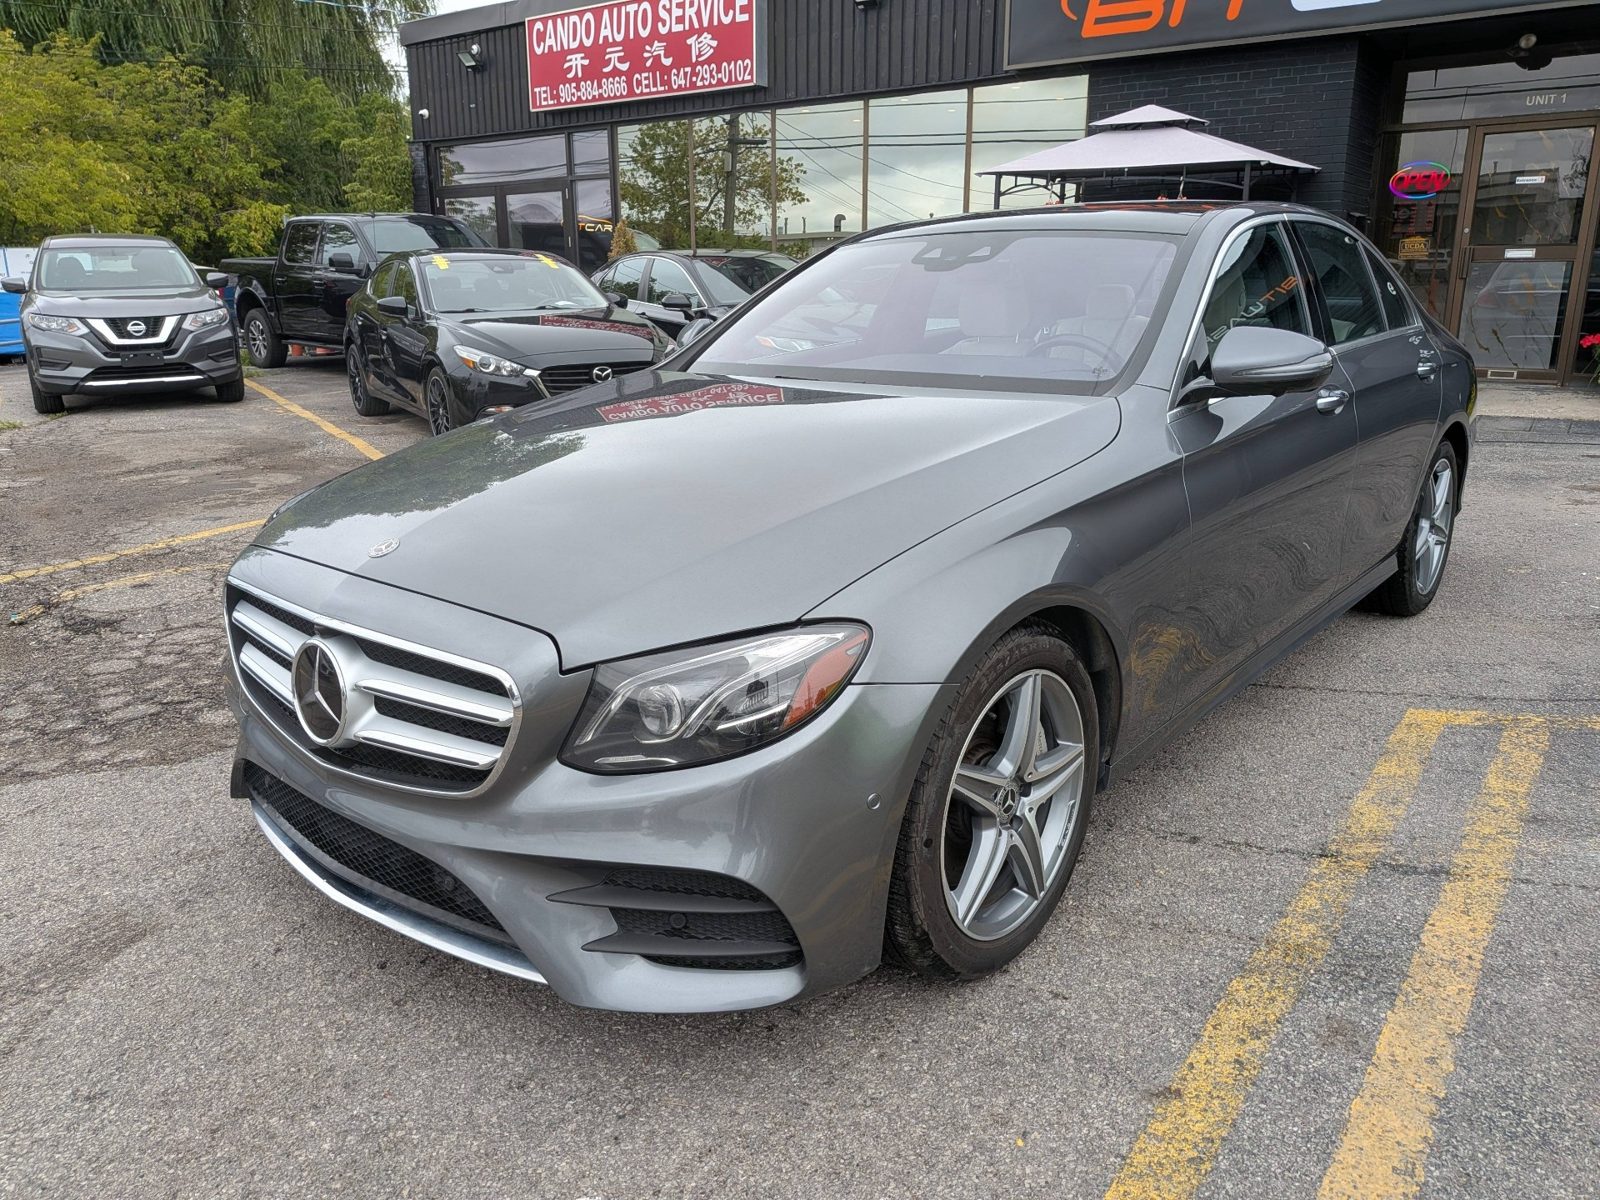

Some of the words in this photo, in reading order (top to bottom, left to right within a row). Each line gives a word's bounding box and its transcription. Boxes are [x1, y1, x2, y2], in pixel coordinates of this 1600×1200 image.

[532, 12, 595, 55] CANDO
[598, 1, 652, 45] AUTO
[657, 0, 749, 35] SERVICE
[563, 32, 718, 79] 开元汽修
[534, 86, 557, 106] TEL:
[559, 75, 628, 103] 905-884-8666
[633, 71, 668, 94] CELL:
[671, 59, 752, 89] 647-293-0102
[1526, 94, 1557, 106] UNIT
[1560, 93, 1567, 104] 1
[1393, 171, 1446, 191] OPEN
[578, 223, 613, 232] TCAR
